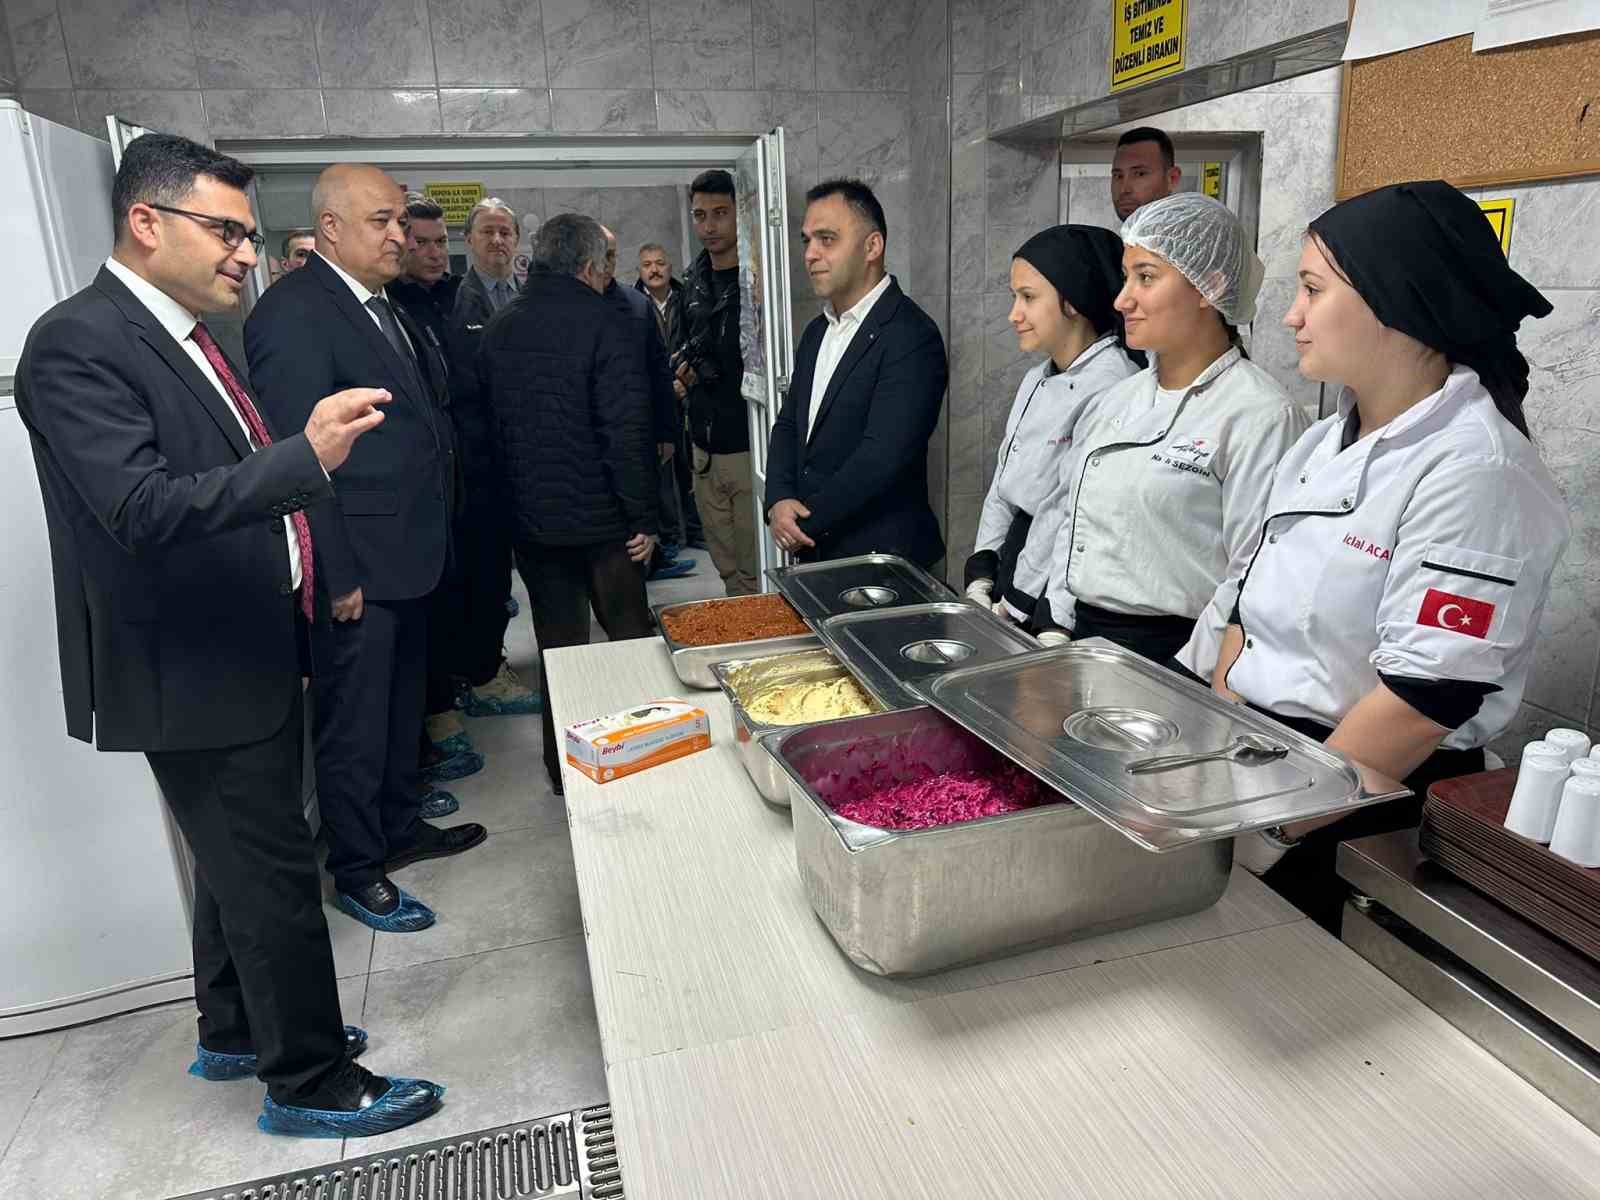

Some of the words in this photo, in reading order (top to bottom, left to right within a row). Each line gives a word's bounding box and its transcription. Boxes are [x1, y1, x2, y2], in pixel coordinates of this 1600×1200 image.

[1124, 1, 1132, 25] İŞ
[1130, 18, 1152, 44] TEMİZ
[1153, 16, 1164, 35] VE
[1114, 45, 1146, 74] DÜZENLİ
[1147, 36, 1179, 63] BIRAKIN
[601, 742, 625, 756] Beybi
